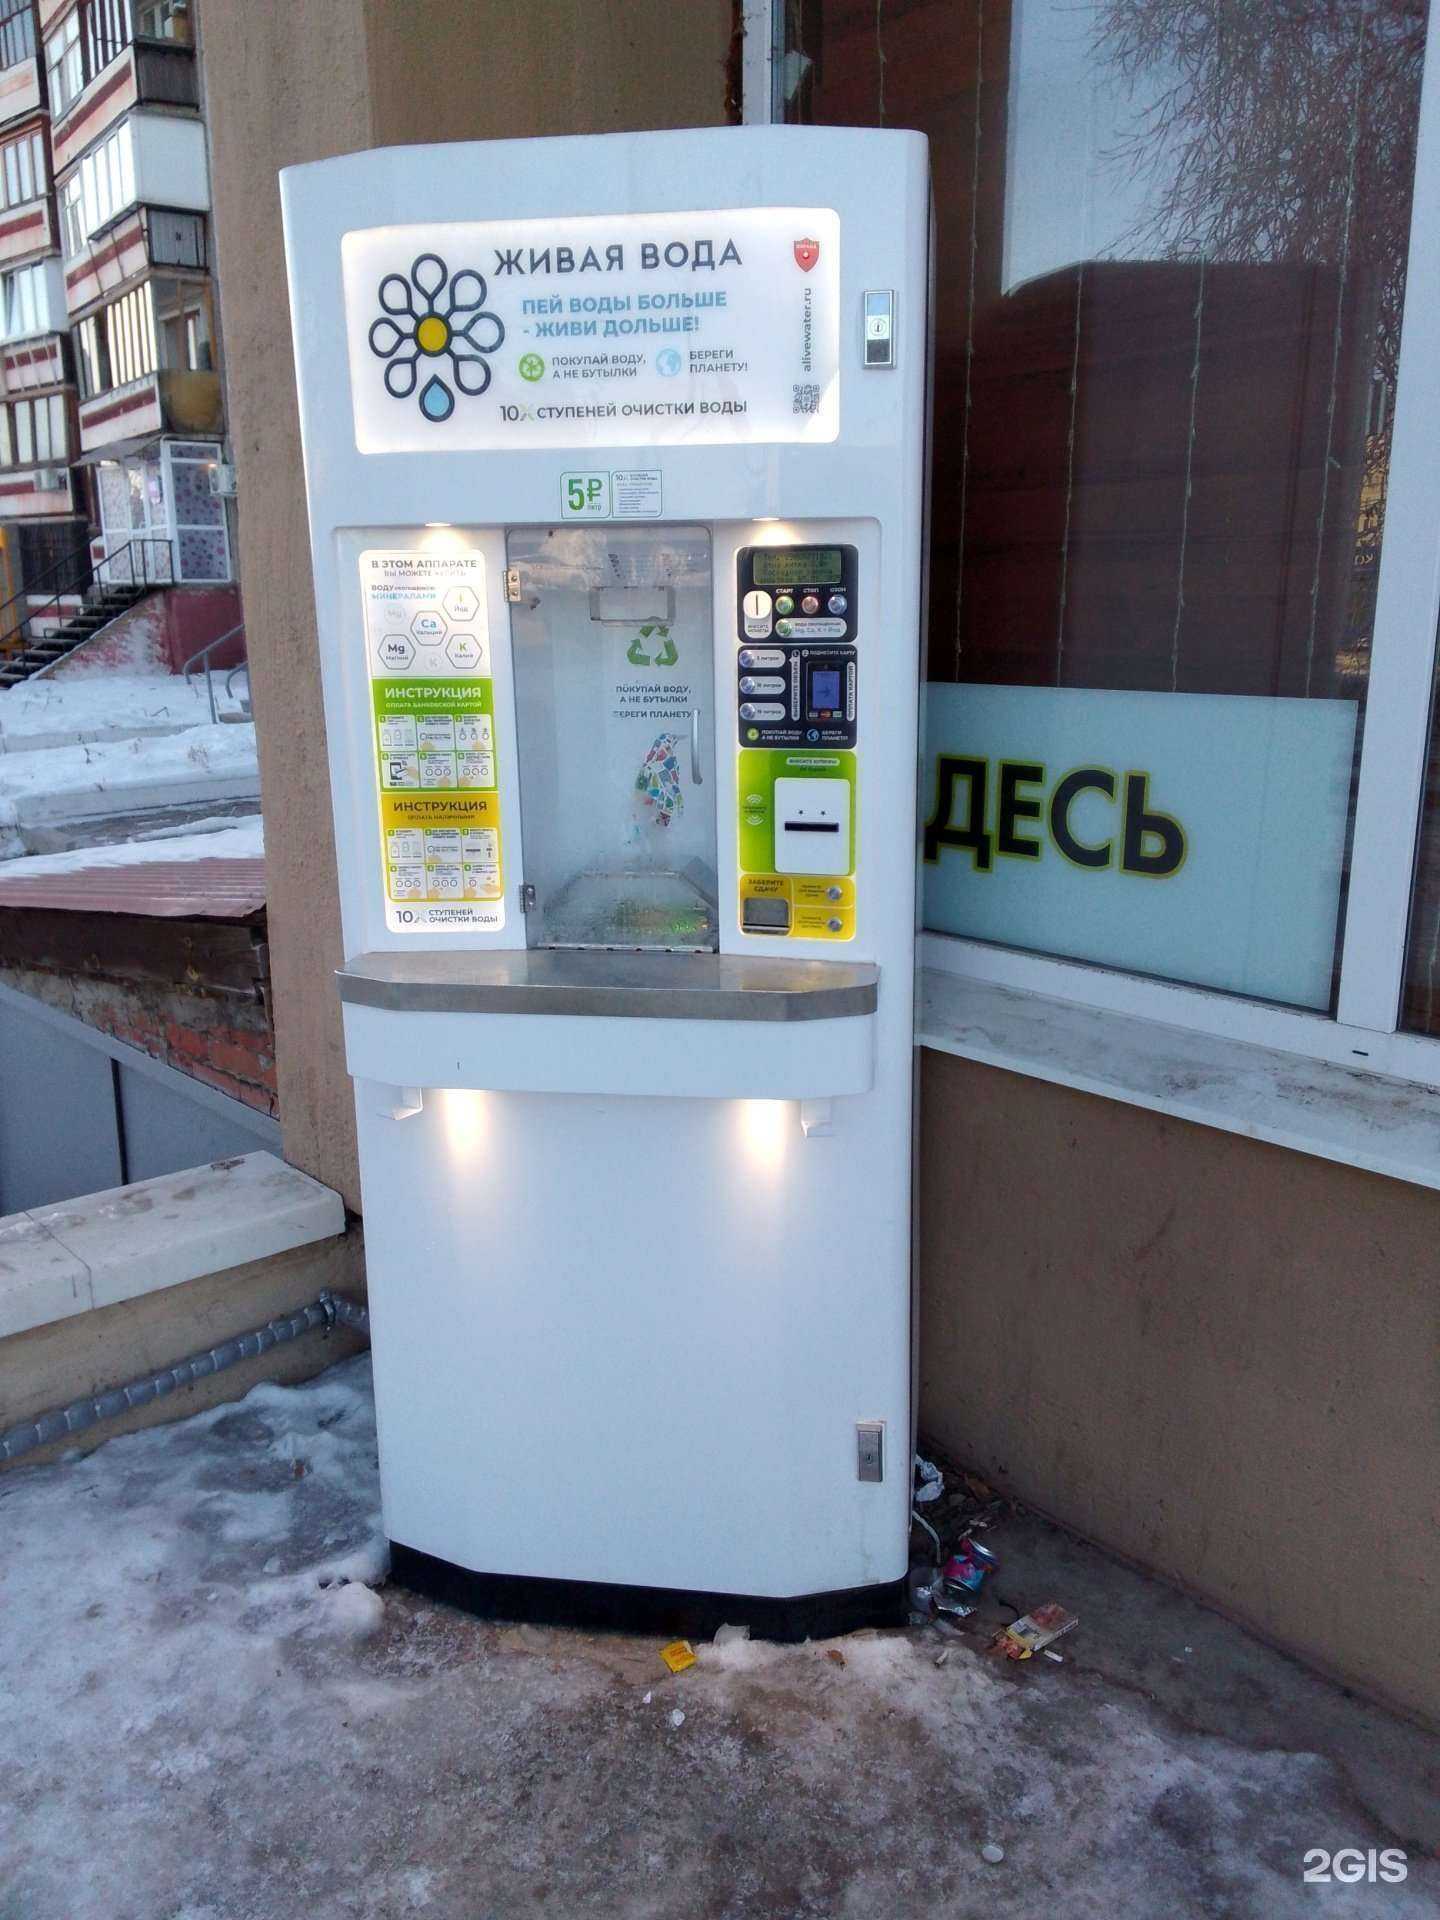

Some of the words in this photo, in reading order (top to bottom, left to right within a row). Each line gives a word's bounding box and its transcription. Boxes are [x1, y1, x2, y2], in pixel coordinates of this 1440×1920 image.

[494, 244, 625, 276] ЖИВАЯ
[641, 238, 743, 272] ВОДА
[522, 293, 563, 315] ПЕЙ
[569, 295, 631, 314] ВОДЫ
[638, 291, 728, 311] БОЛЬШЕ
[536, 320, 598, 338] ЖИВИ
[602, 316, 700, 338] ДОЛЬШЕ!
[801, 287, 812, 372] alivewater.ru
[552, 353, 609, 366] ПОКУПАЙ
[611, 353, 646, 365] ВОДУ,
[689, 350, 734, 360] БЕРЕГИ
[552, 370, 561, 379] А
[564, 369, 579, 379] НЕ
[582, 367, 637, 379] БУТЫЛКИ
[689, 362, 749, 374] ПЛАНЕТУ!
[537, 402, 617, 419] СТУПЕНЕЙ
[622, 403, 695, 417] ОЧИСТКИ
[700, 400, 747, 415] ВОДЫ
[371, 560, 379, 569] В
[382, 560, 413, 569] ЭТОМ
[416, 559, 477, 568] АППАРАТЕ
[421, 619, 437, 628] Ca
[387, 643, 405, 655] Mg
[384, 687, 482, 699] ИНСТРУКЦИЯ
[616, 683, 661, 693] ПОКУПАЙ
[620, 695, 627, 703] А
[628, 695, 641, 703] НЕ
[643, 695, 688, 703] БУТЫЛКИ
[393, 801, 488, 813] ИНСТРУКЦИЯ
[428, 908, 474, 916] СТУПЕНЕЙ
[472, 915, 498, 923] ВОДЫ
